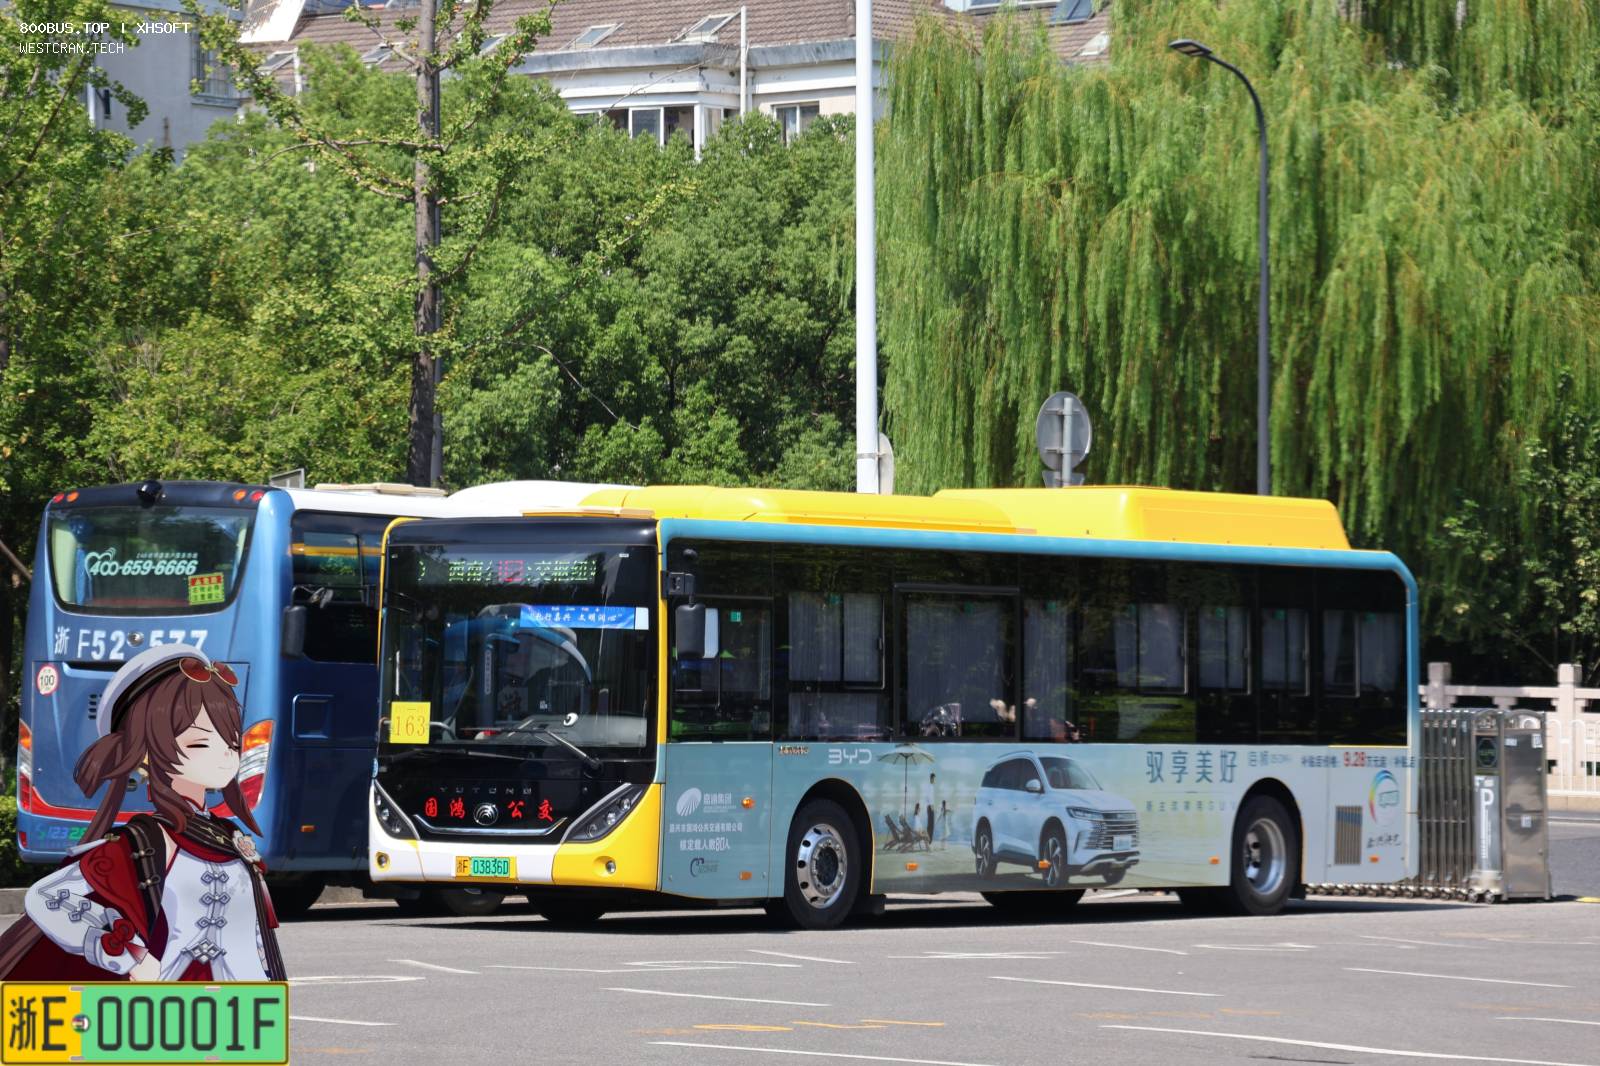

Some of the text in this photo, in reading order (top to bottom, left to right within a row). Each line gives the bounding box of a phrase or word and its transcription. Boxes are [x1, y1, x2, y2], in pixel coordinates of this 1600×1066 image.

[89, 560, 198, 576] 400-659-6666
[40, 674, 55, 687] 100
[396, 716, 426, 737] 163
[828, 748, 872, 764] BYD
[1146, 750, 1238, 784] 驭享美好
[440, 786, 532, 795] YUTONG
